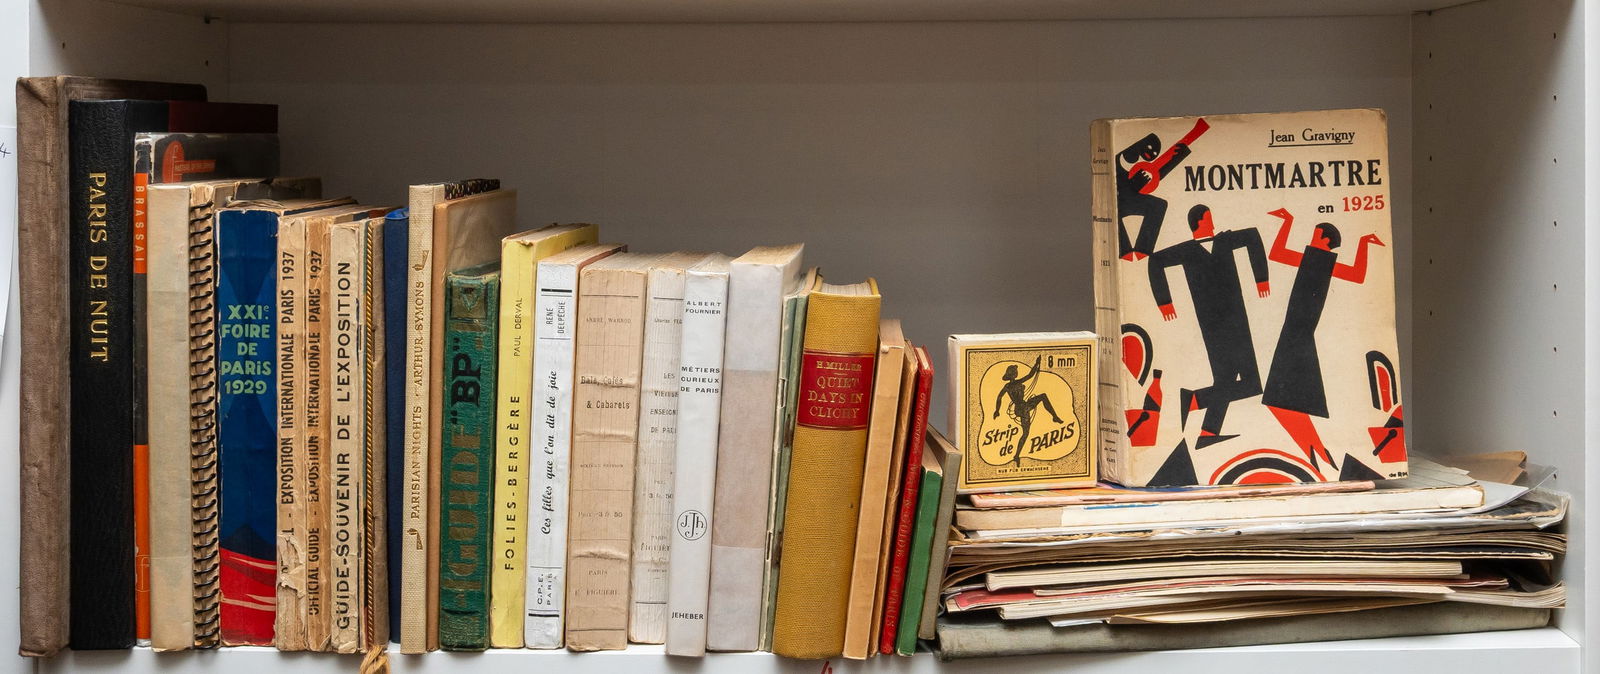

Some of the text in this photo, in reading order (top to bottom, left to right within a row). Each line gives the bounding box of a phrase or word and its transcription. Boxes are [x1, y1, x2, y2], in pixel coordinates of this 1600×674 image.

[1270, 128, 1355, 144] Jean Gravigny
[1184, 159, 1382, 192] MONTMARTRE
[1317, 195, 1385, 214] en 1925
[89, 172, 109, 362] PARIS DE NUIT
[282, 252, 295, 281] 1937
[310, 251, 322, 280] 1937
[281, 289, 294, 324] PARIS
[308, 288, 320, 323] PARIS
[221, 324, 270, 339] FOIRE
[237, 342, 258, 356] DE
[1047, 356, 1075, 368] 8 mm
[280, 333, 294, 428] INTERNATIONALE
[308, 332, 320, 428] INTERNATIONALE
[681, 366, 720, 374] MÉTIERS
[816, 361, 862, 371] H.MILLER
[225, 380, 267, 395] 1929
[808, 391, 864, 403] DAYS IN
[817, 377, 860, 389] QUIET
[411, 281, 424, 520] PARISIAN NIGHTS ARTHUR SYMONS
[586, 400, 630, 409] & Cabarets
[810, 406, 860, 419] CLICHY
[336, 262, 351, 630] GUIDE-SOUVENIR DE L'EXPOSITION
[982, 424, 1018, 446] Strip
[1000, 441, 1013, 457] de
[1029, 422, 1075, 454] PARIS
[541, 371, 560, 535] Ces filles que l'on dit de joie
[281, 438, 294, 504] EXPOSITION
[504, 396, 520, 571] FOLIES-BERGÈRE
[449, 424, 481, 577] GUIDE
[309, 528, 319, 562] GUIDE
[672, 612, 704, 620] JEHEBER
